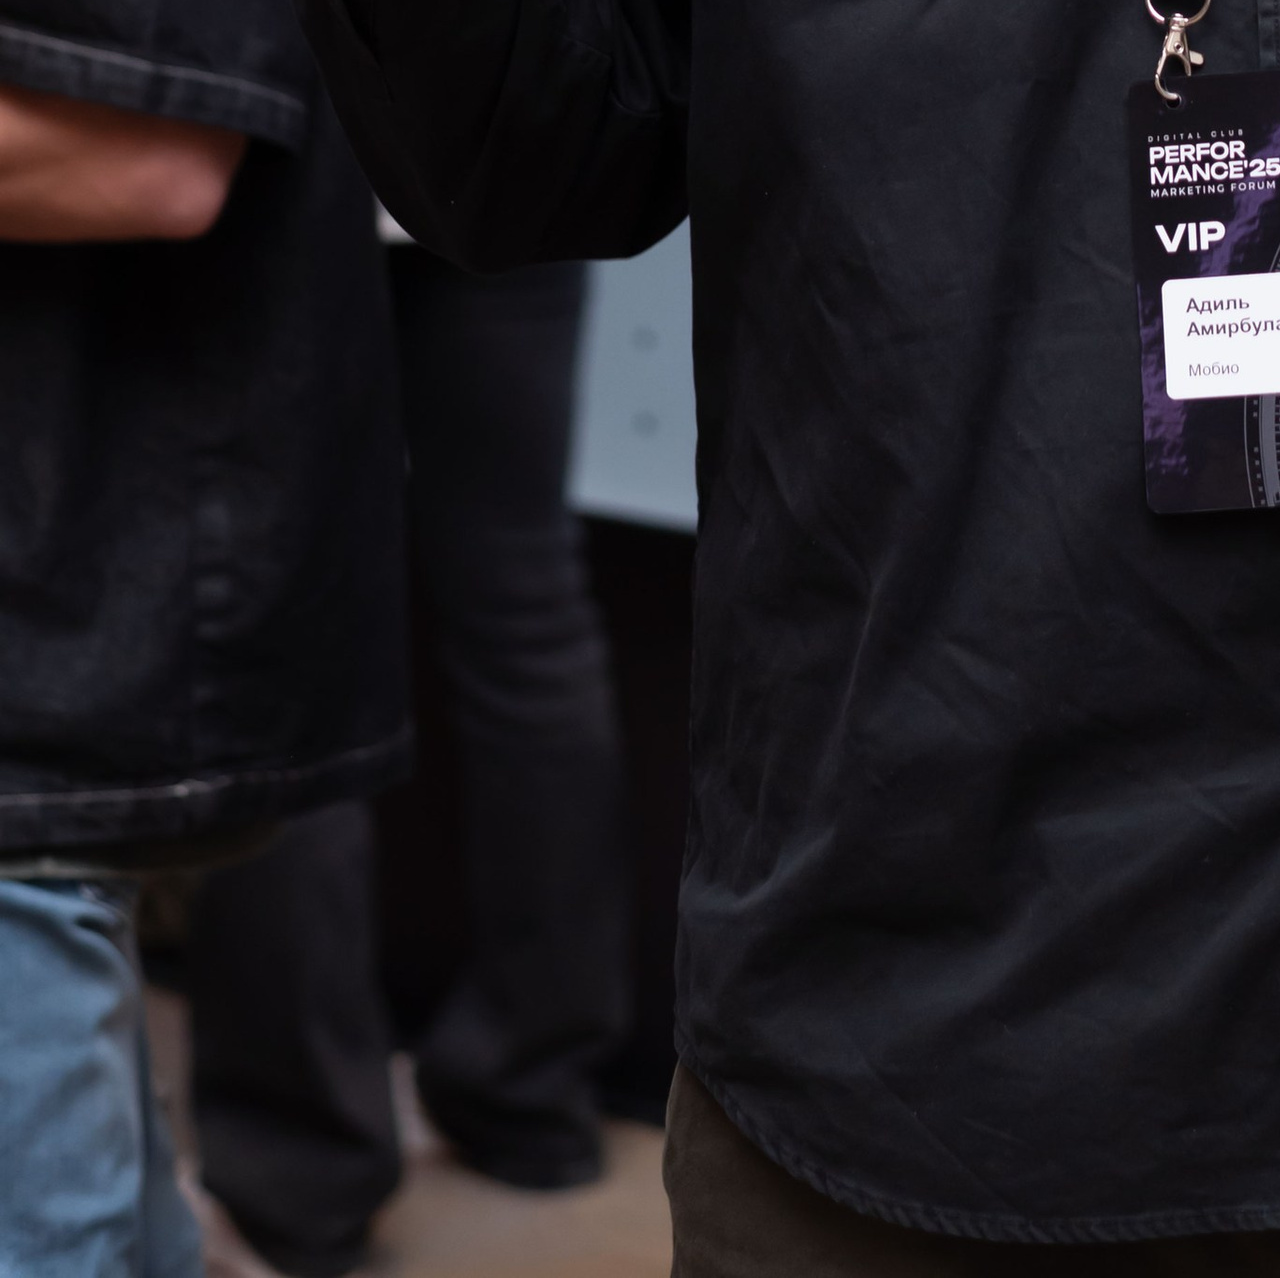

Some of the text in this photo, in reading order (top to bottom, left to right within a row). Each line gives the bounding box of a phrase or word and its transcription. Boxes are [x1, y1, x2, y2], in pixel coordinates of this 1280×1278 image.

[1148, 128, 1244, 143] DIGITAL CLUB
[1149, 140, 1246, 165] PERFOR
[1150, 180, 1276, 198] MARKETING FORUM
[1155, 220, 1226, 253] VIP
[1186, 297, 1250, 315] Адиль
[1188, 361, 1240, 377] Мобио
